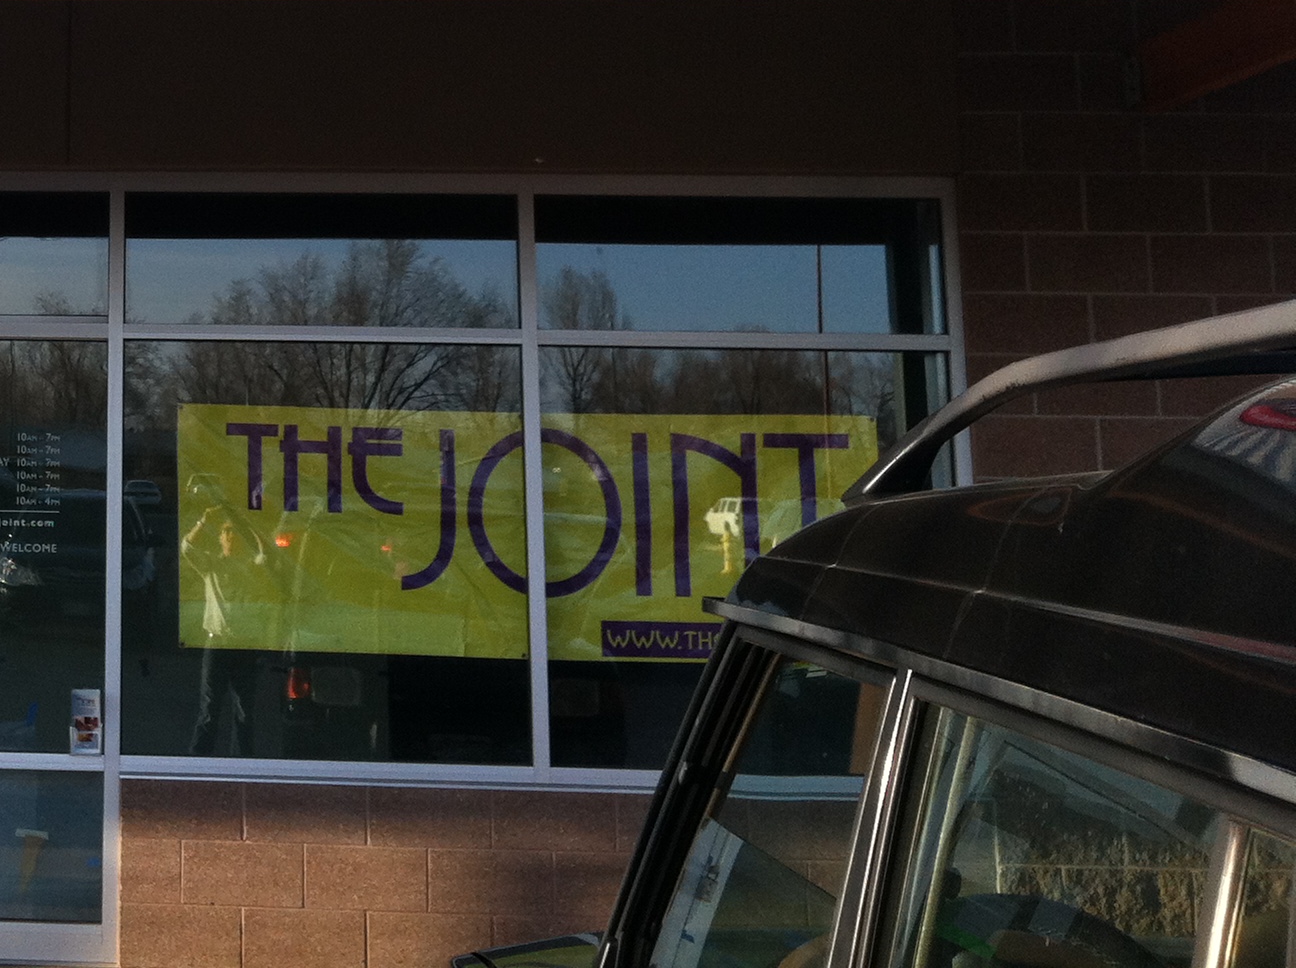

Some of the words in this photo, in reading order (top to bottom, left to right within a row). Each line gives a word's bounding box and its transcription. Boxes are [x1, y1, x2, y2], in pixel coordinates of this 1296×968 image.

[0, 543, 58, 553] WELCOME
[225, 422, 403, 516] THE
[401, 426, 849, 600] JOINT
